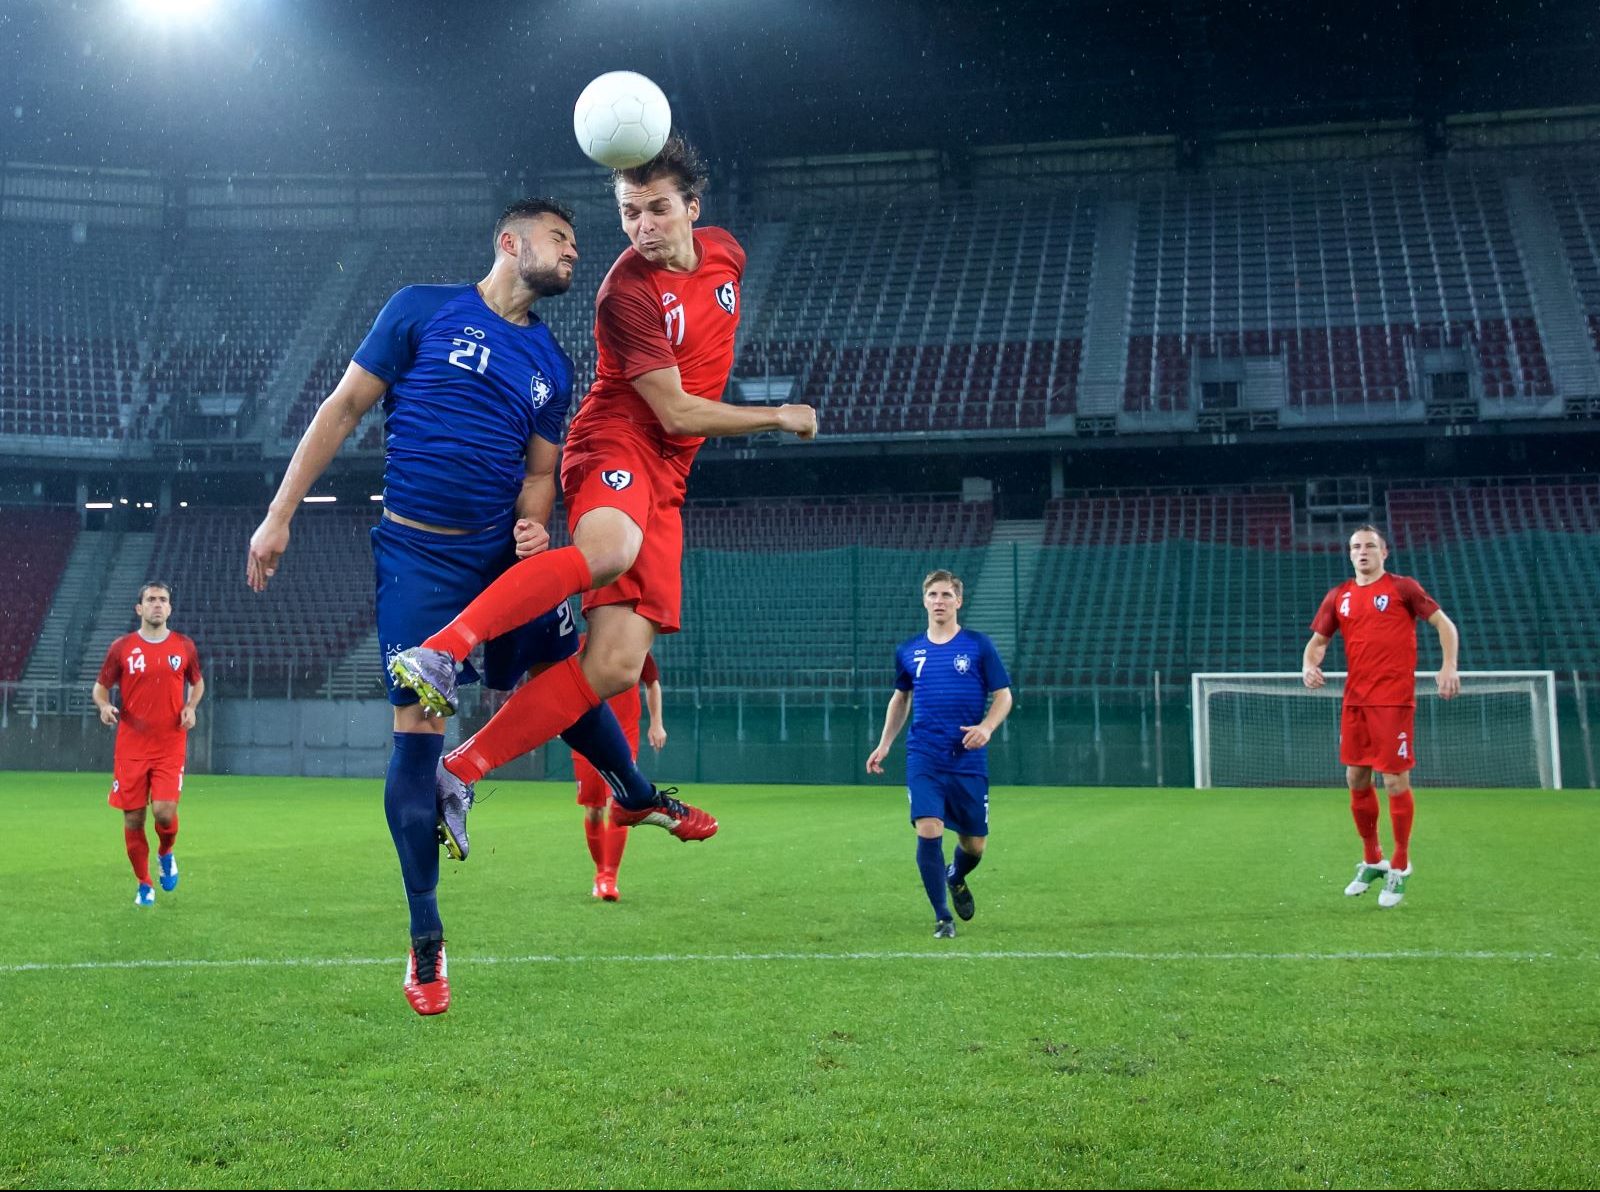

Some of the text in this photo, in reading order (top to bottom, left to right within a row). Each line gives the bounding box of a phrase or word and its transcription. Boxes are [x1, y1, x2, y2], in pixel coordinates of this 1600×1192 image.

[449, 338, 491, 375] 21
[1340, 598, 1350, 616] 4
[557, 600, 576, 637] 2
[127, 654, 146, 674] 14
[914, 657, 926, 678] 7
[1398, 741, 1408, 759] 4
